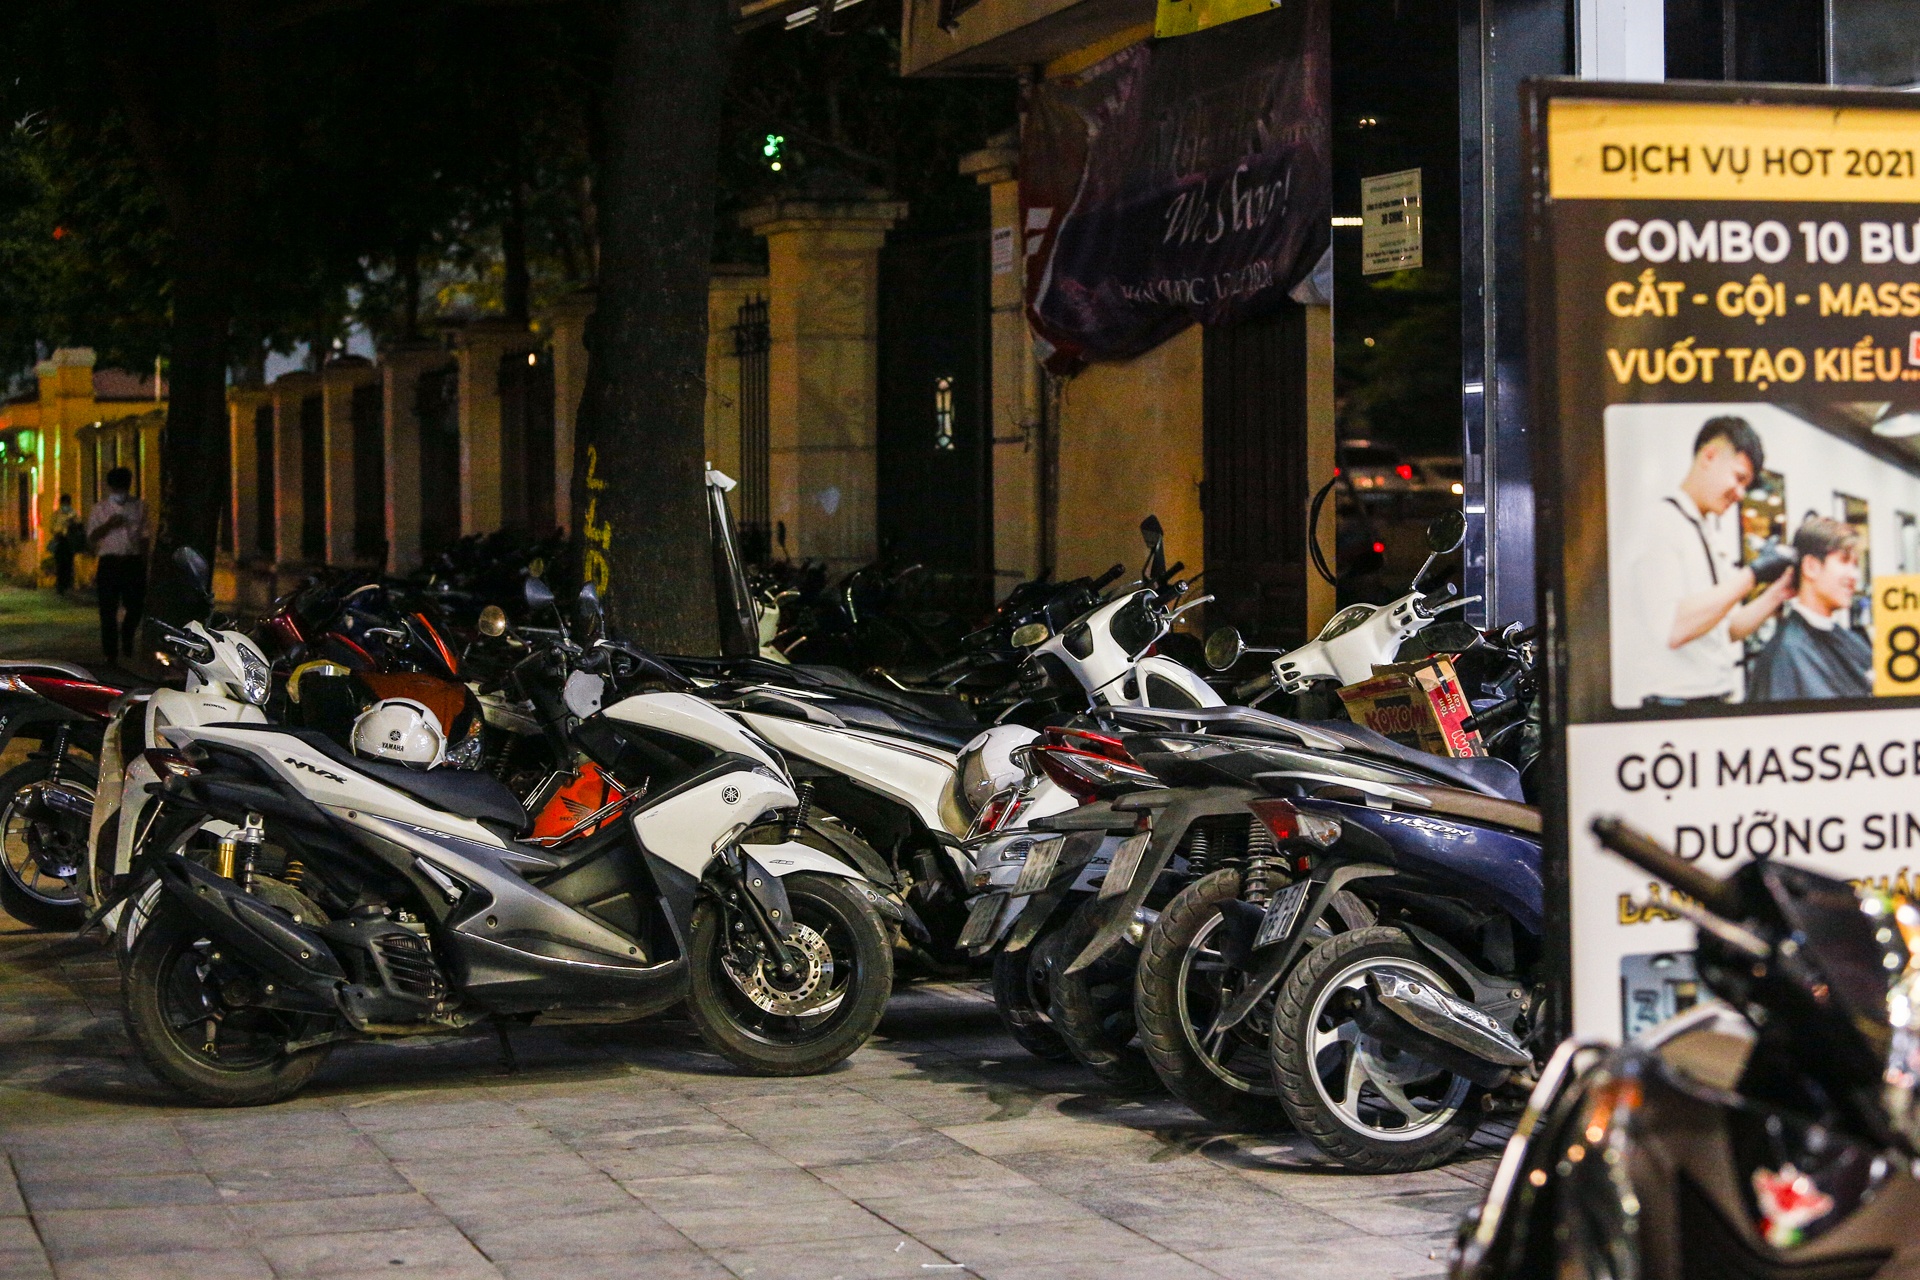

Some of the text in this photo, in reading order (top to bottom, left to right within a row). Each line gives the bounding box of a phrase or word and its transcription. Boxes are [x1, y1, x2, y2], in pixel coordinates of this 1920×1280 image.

[1602, 144, 1915, 184] DỊCH VỤ HOT 2021
[1604, 219, 1792, 263] COMBO
[1799, 220, 1849, 264] 10
[1605, 267, 1685, 317] CẮT
[1715, 273, 1786, 325] GỘI
[1818, 282, 1920, 318] MASS
[1607, 336, 1720, 384] VUỐT
[1726, 347, 1806, 391] TẠO
[382, 741, 404, 752] YAMAHA
[283, 757, 347, 785] NVX
[1616, 742, 1698, 801] GỘI
[413, 825, 451, 839] 155
[1379, 814, 1475, 837] VISION
[1676, 810, 1845, 862] DƯỠNG
